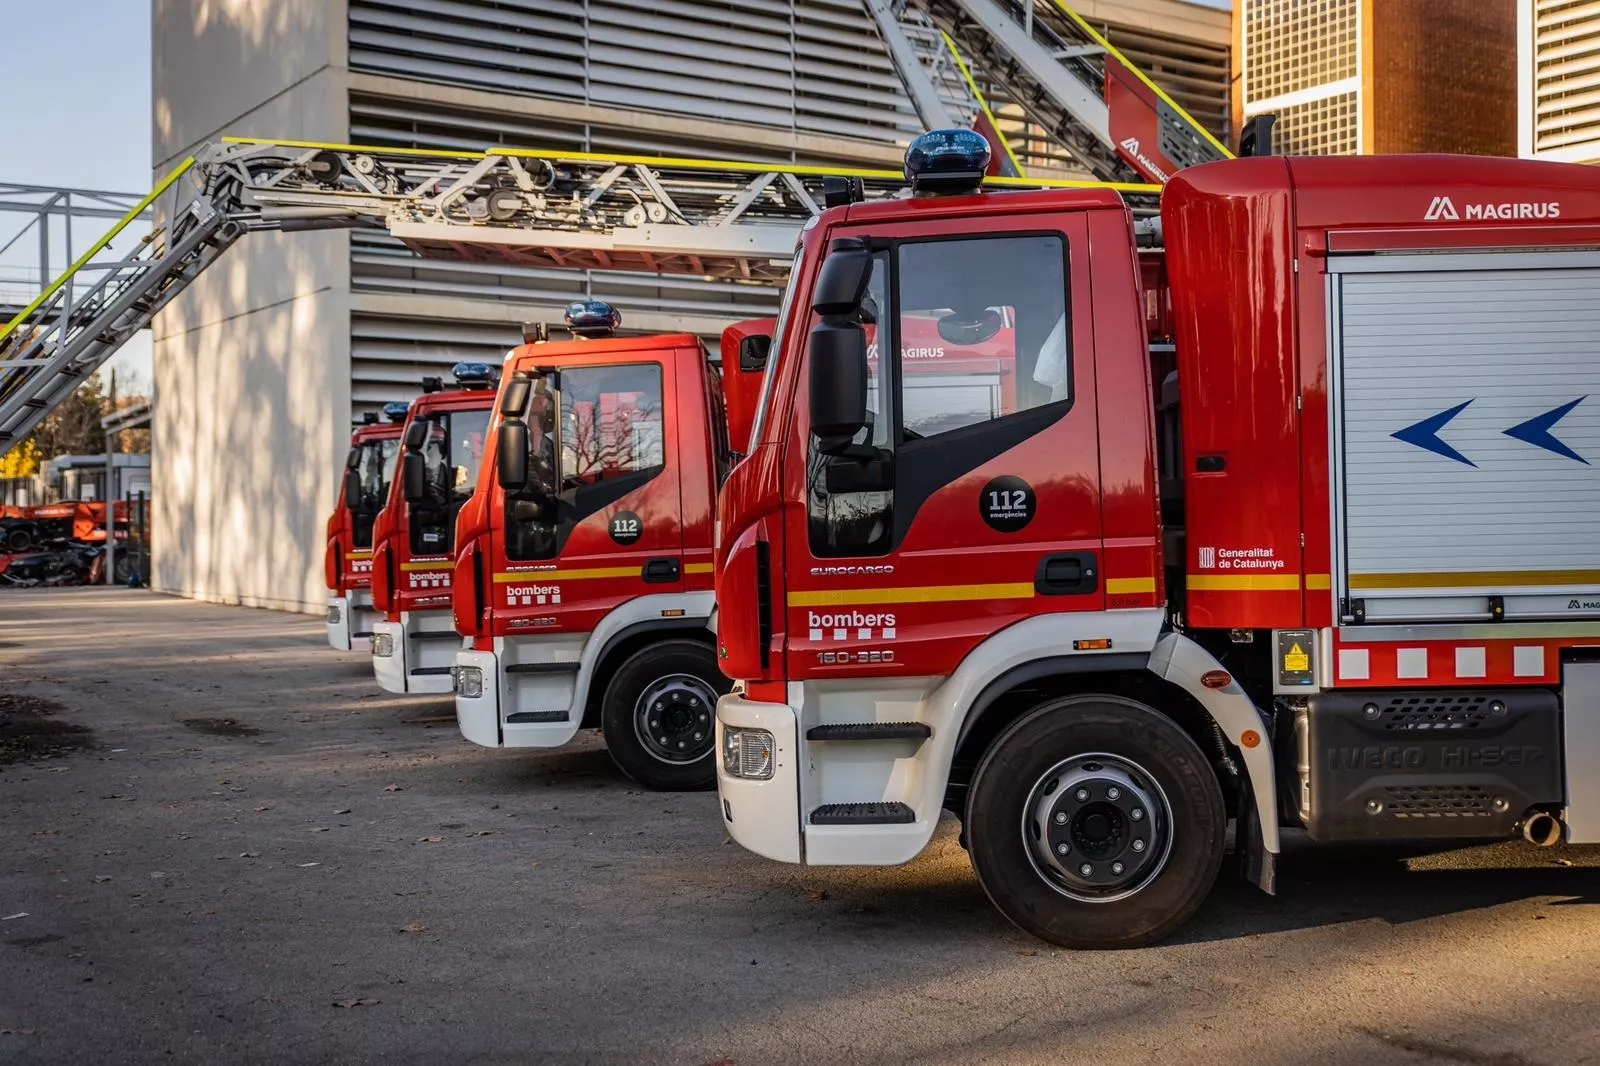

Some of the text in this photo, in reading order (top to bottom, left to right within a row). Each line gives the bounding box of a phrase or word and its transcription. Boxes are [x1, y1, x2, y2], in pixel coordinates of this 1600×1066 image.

[1466, 202, 1561, 220] MAGIRUS
[901, 347, 944, 359] AGIRUS
[989, 490, 1026, 510] 112
[614, 519, 638, 532] 112
[1218, 548, 1274, 558] Generalitat
[810, 565, 895, 576] EUROCARGO
[1218, 559, 1285, 570] de Catalunya
[409, 571, 450, 581] bombers
[506, 584, 561, 596] bombers
[808, 610, 896, 627] bombers
[816, 650, 895, 664] 160-320
[1327, 743, 1544, 770] IVECO HI-SCR
